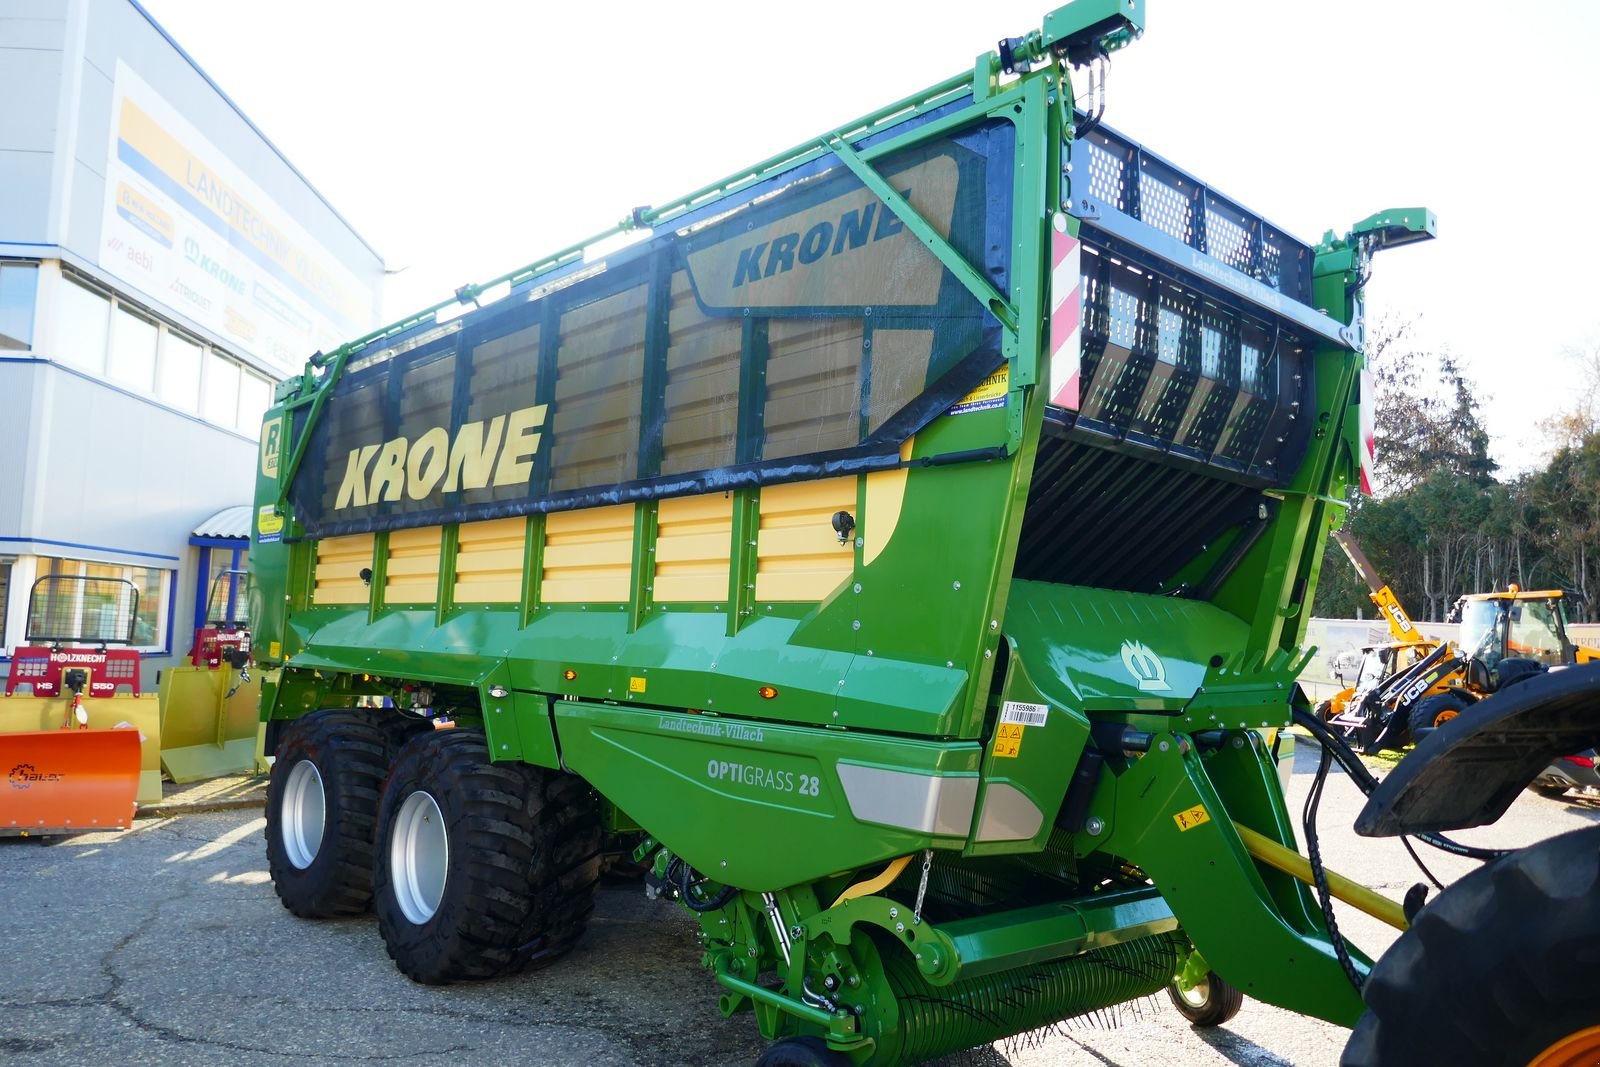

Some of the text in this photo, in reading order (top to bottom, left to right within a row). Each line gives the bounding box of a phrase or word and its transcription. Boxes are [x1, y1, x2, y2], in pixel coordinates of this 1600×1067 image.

[186, 159, 290, 264] LANDTECHNIK
[732, 188, 912, 288] KRONE
[127, 246, 153, 273] aebi
[199, 254, 247, 296] KRONE
[334, 403, 549, 511] KRONE
[1387, 602, 1412, 633] JCB
[50, 652, 107, 663] HOLZKNECHT
[37, 682, 115, 690] HS 550
[1402, 678, 1428, 707] JCB
[658, 716, 764, 742] Landtechnik-Villach
[707, 759, 820, 797] OPTIGRASS 28
